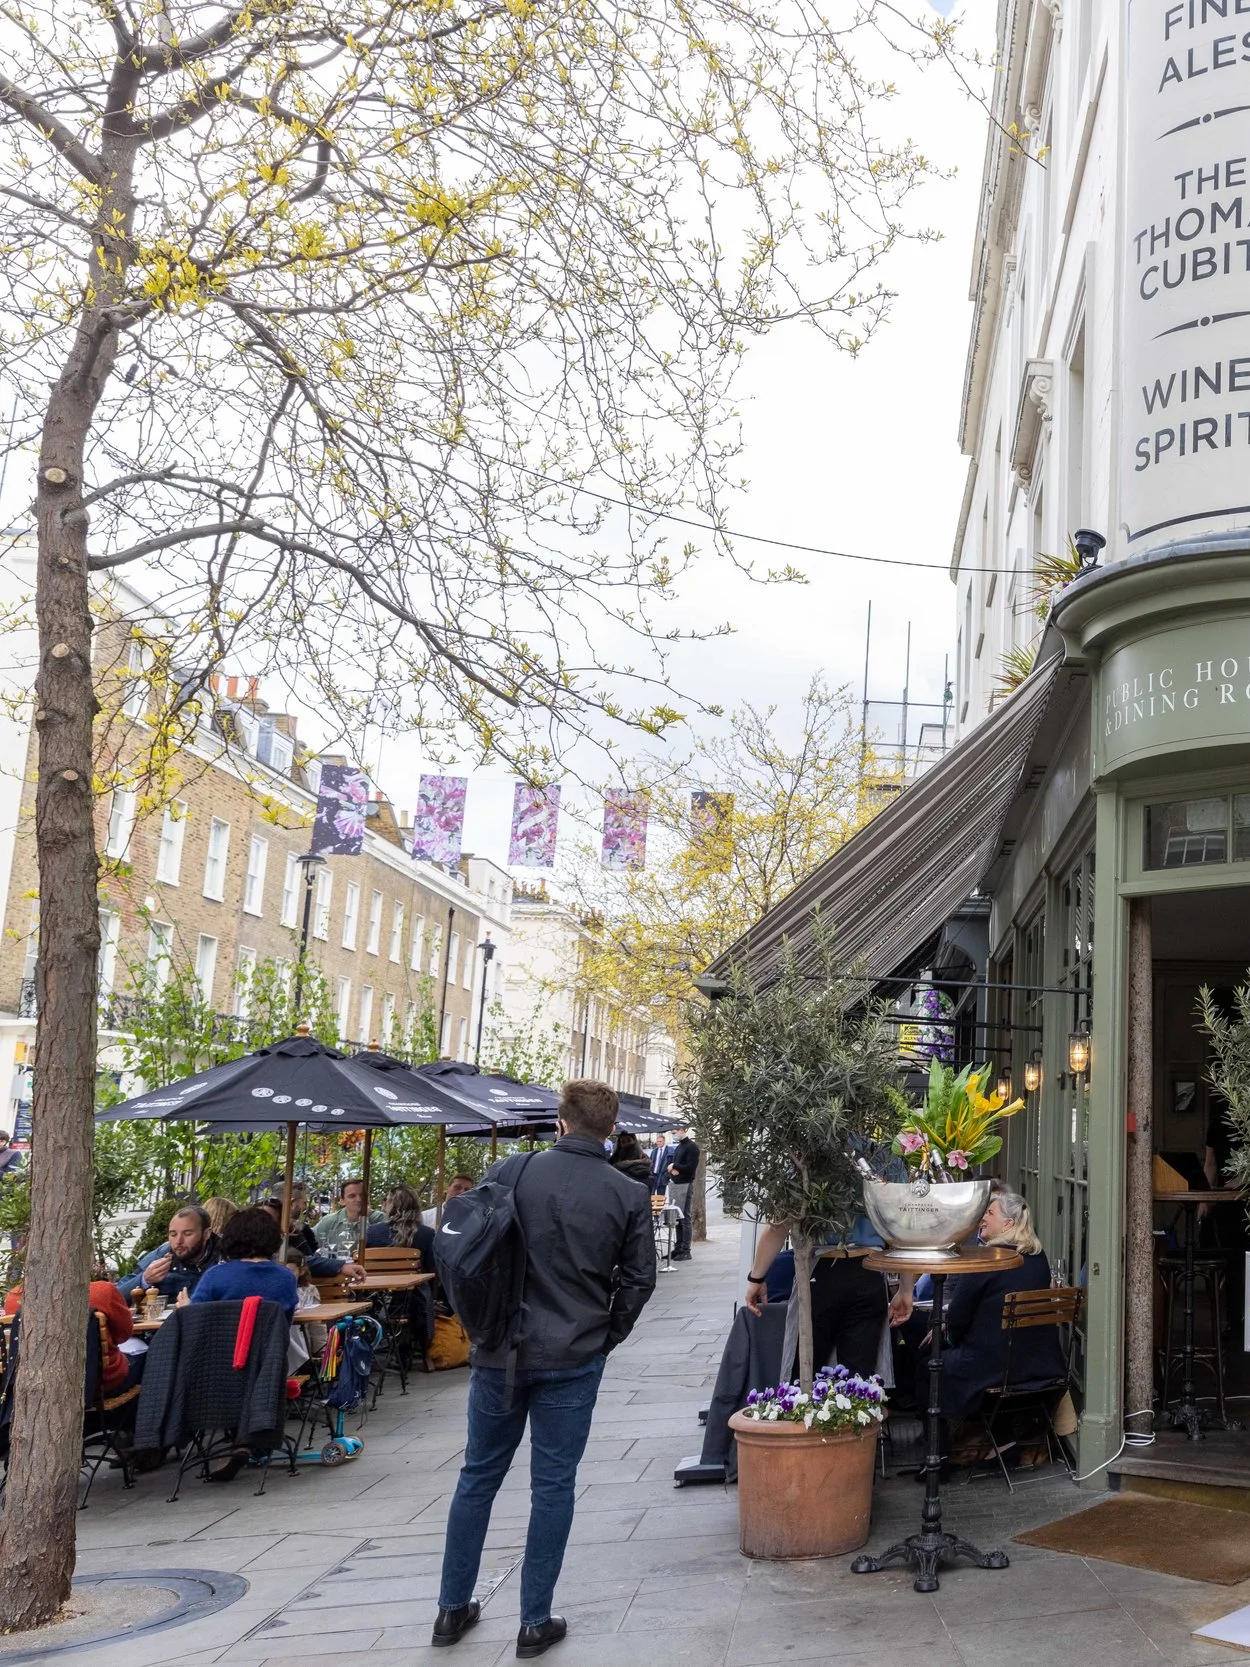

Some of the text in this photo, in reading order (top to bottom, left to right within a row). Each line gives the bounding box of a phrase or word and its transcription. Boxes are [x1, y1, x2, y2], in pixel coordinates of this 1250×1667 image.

[1174, 157, 1247, 200] THE
[1105, 668, 1173, 714] PUBLIC
[1114, 691, 1199, 731] DINING
